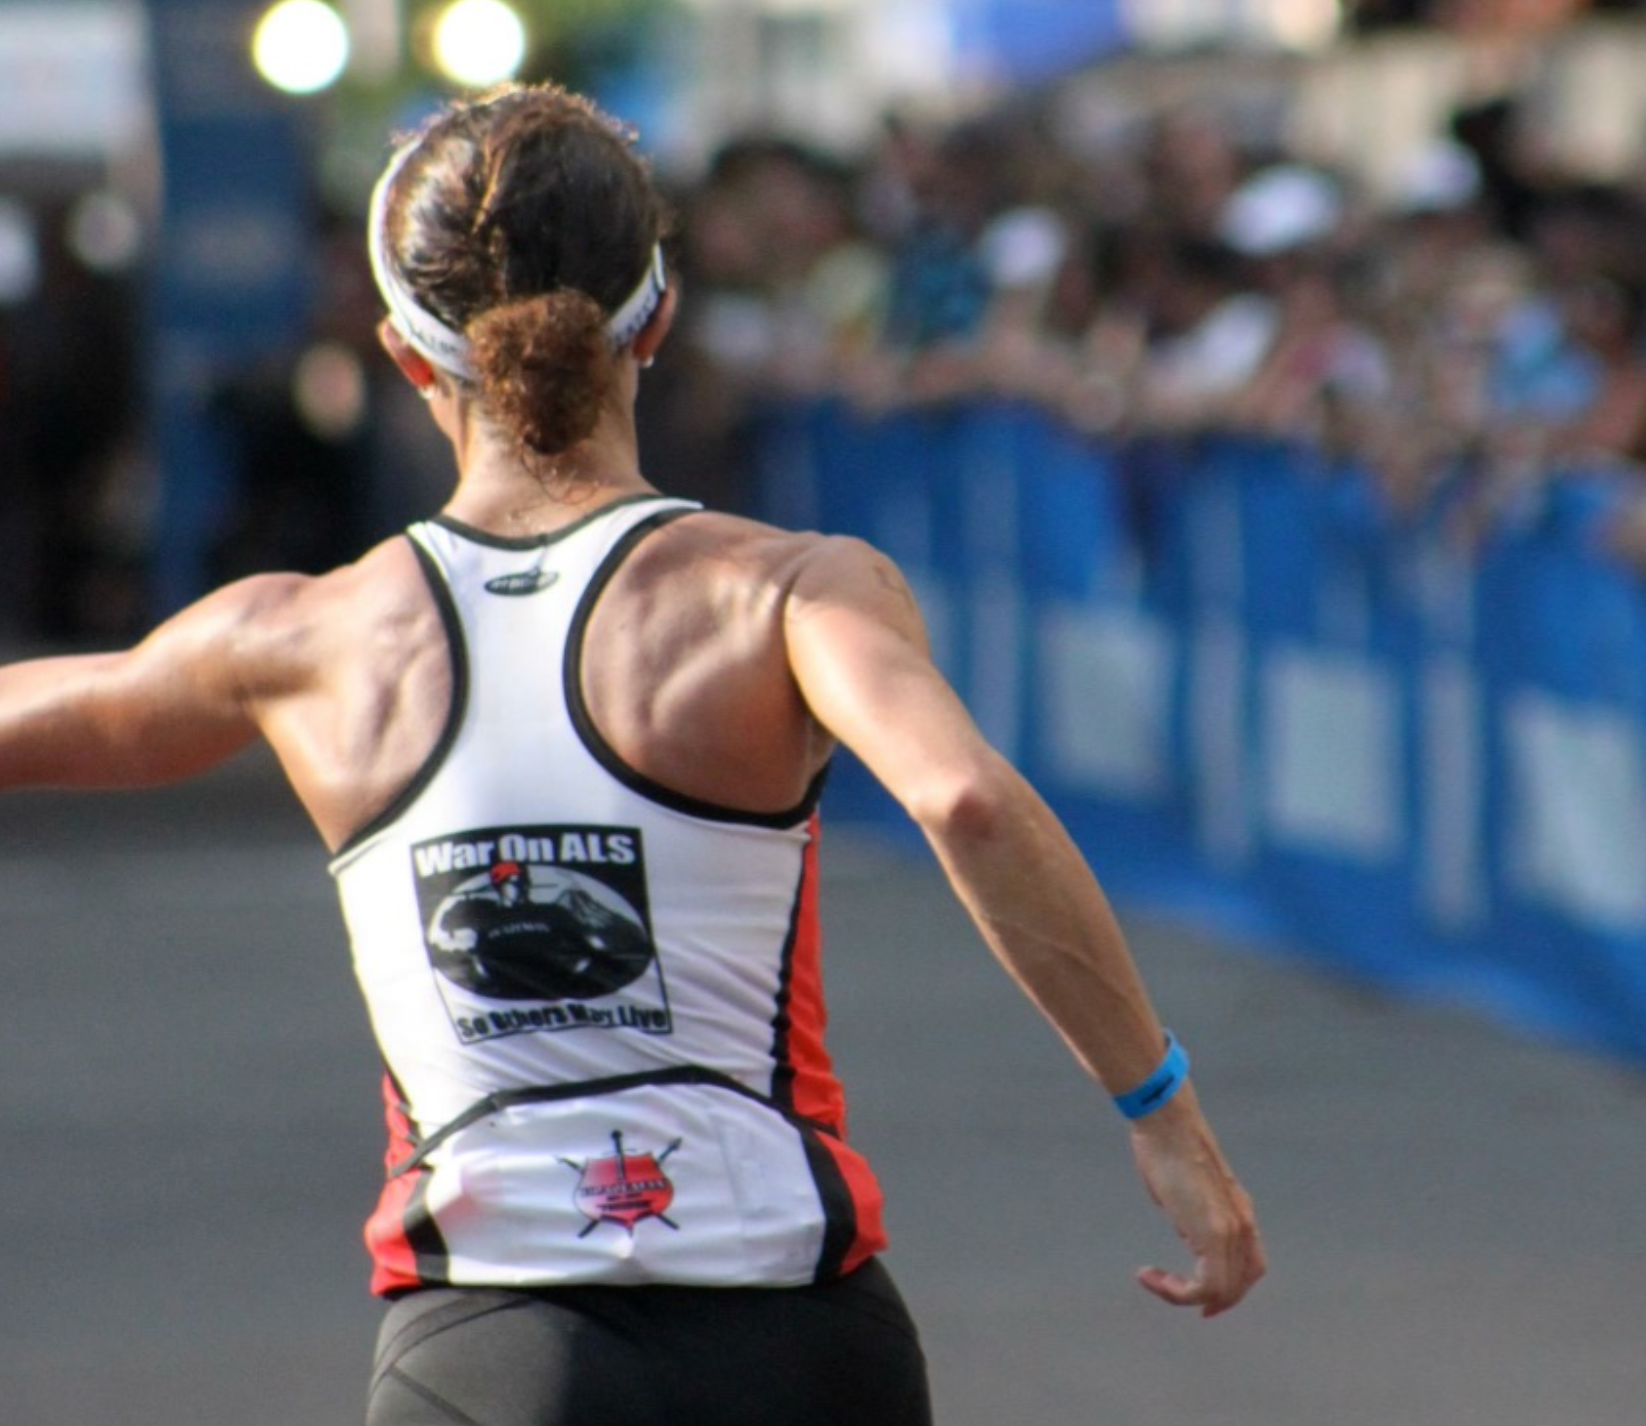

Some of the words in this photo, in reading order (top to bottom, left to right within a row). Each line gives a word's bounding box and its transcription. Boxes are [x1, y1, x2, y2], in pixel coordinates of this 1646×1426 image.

[415, 841, 494, 877] War
[499, 834, 554, 862] On
[561, 833, 635, 863] ALS
[456, 1017, 489, 1037] So
[568, 1003, 614, 1027] May
[619, 1005, 666, 1028] Live
